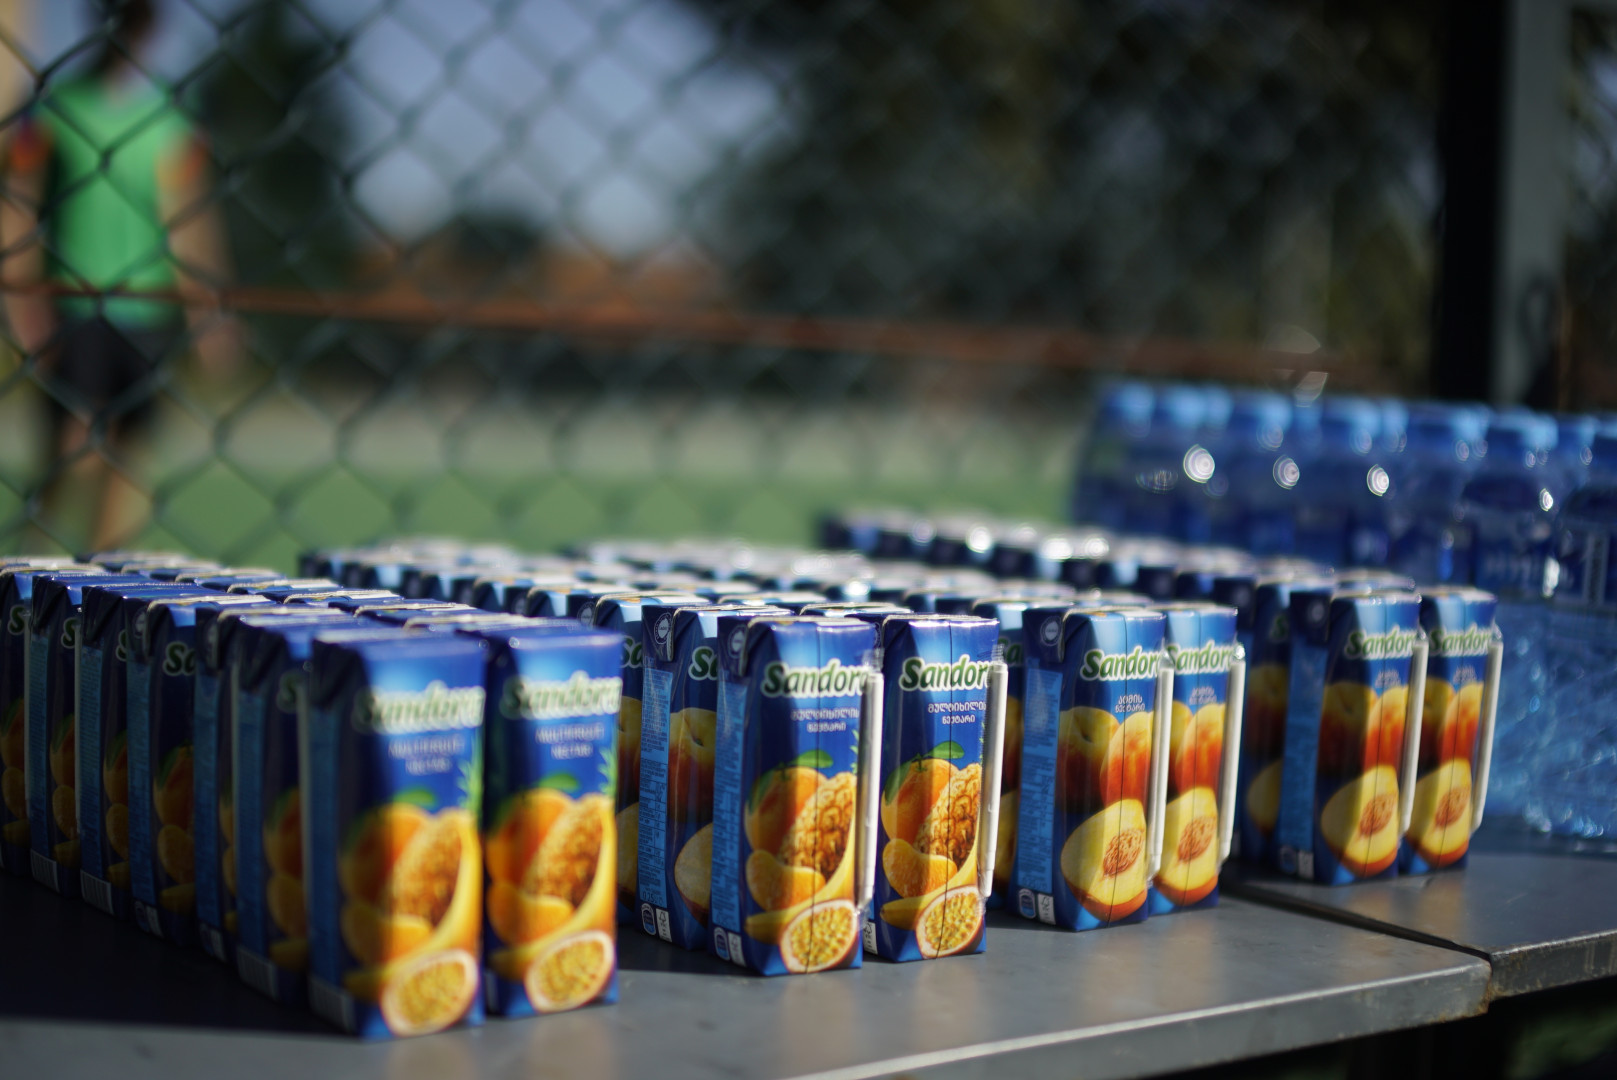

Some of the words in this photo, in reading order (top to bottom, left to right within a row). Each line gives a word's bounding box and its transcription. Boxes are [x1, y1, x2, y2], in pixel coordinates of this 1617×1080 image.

[1346, 624, 1415, 659] Sandor
[1429, 622, 1490, 656] Sandor
[900, 654, 992, 691] Sandor
